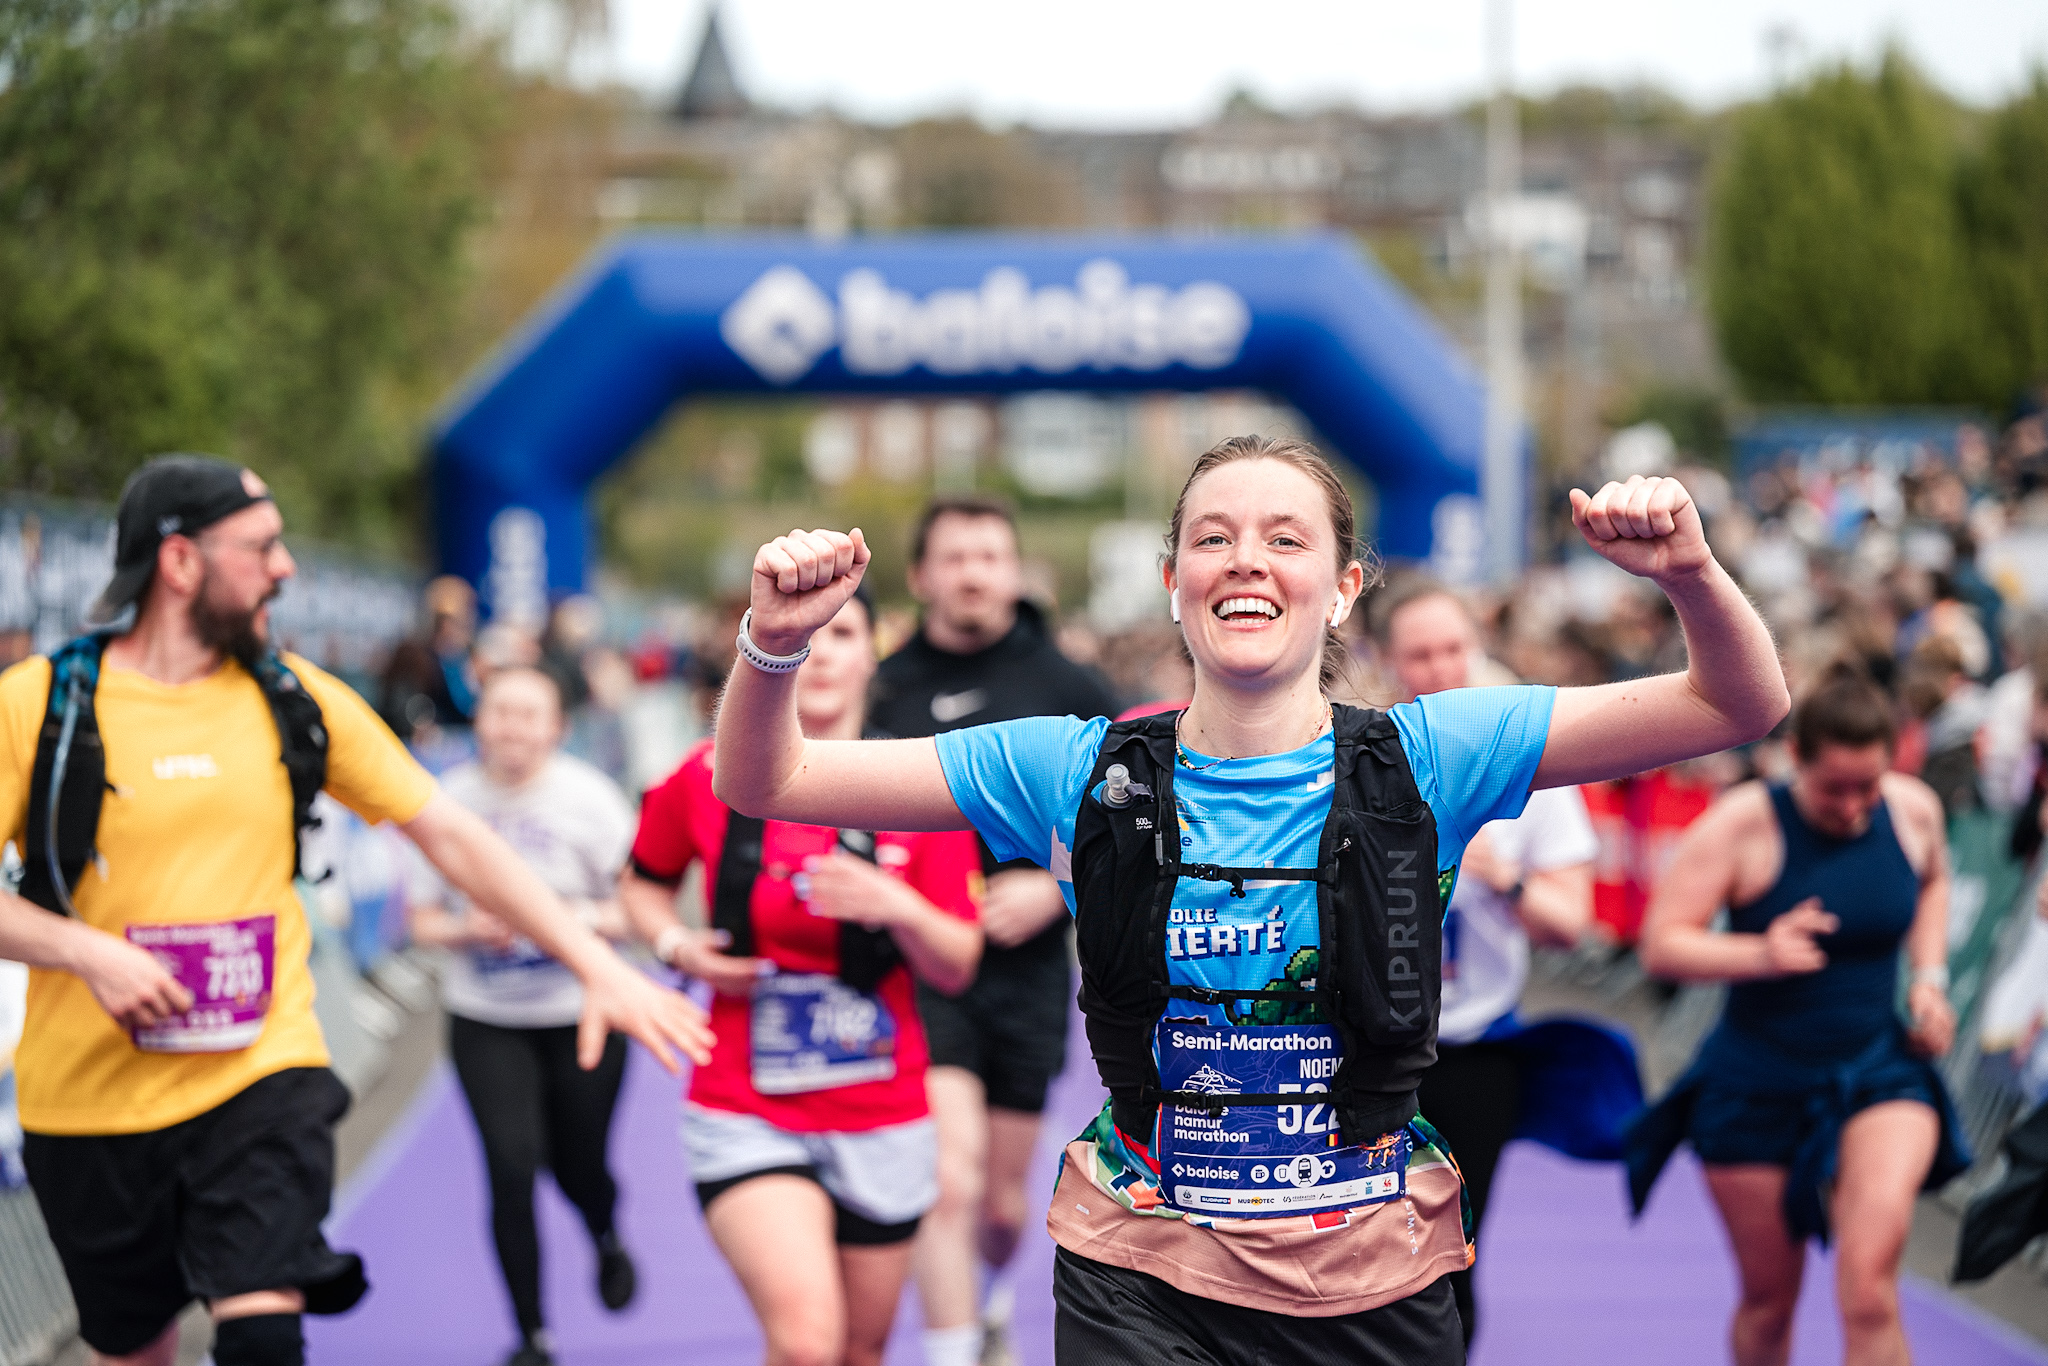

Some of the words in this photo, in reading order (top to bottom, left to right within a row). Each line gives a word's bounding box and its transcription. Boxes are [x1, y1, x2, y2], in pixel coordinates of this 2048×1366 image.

[840, 260, 1251, 375] baloise
[1388, 851, 1421, 1031] KIPRUN
[1172, 1031, 1332, 1050] Semi-Marathon
[1174, 1115, 1222, 1129] namur
[1174, 1128, 1249, 1143] marathon
[1187, 1164, 1240, 1181] baloise
[1405, 1201, 1419, 1255] LIMITS
